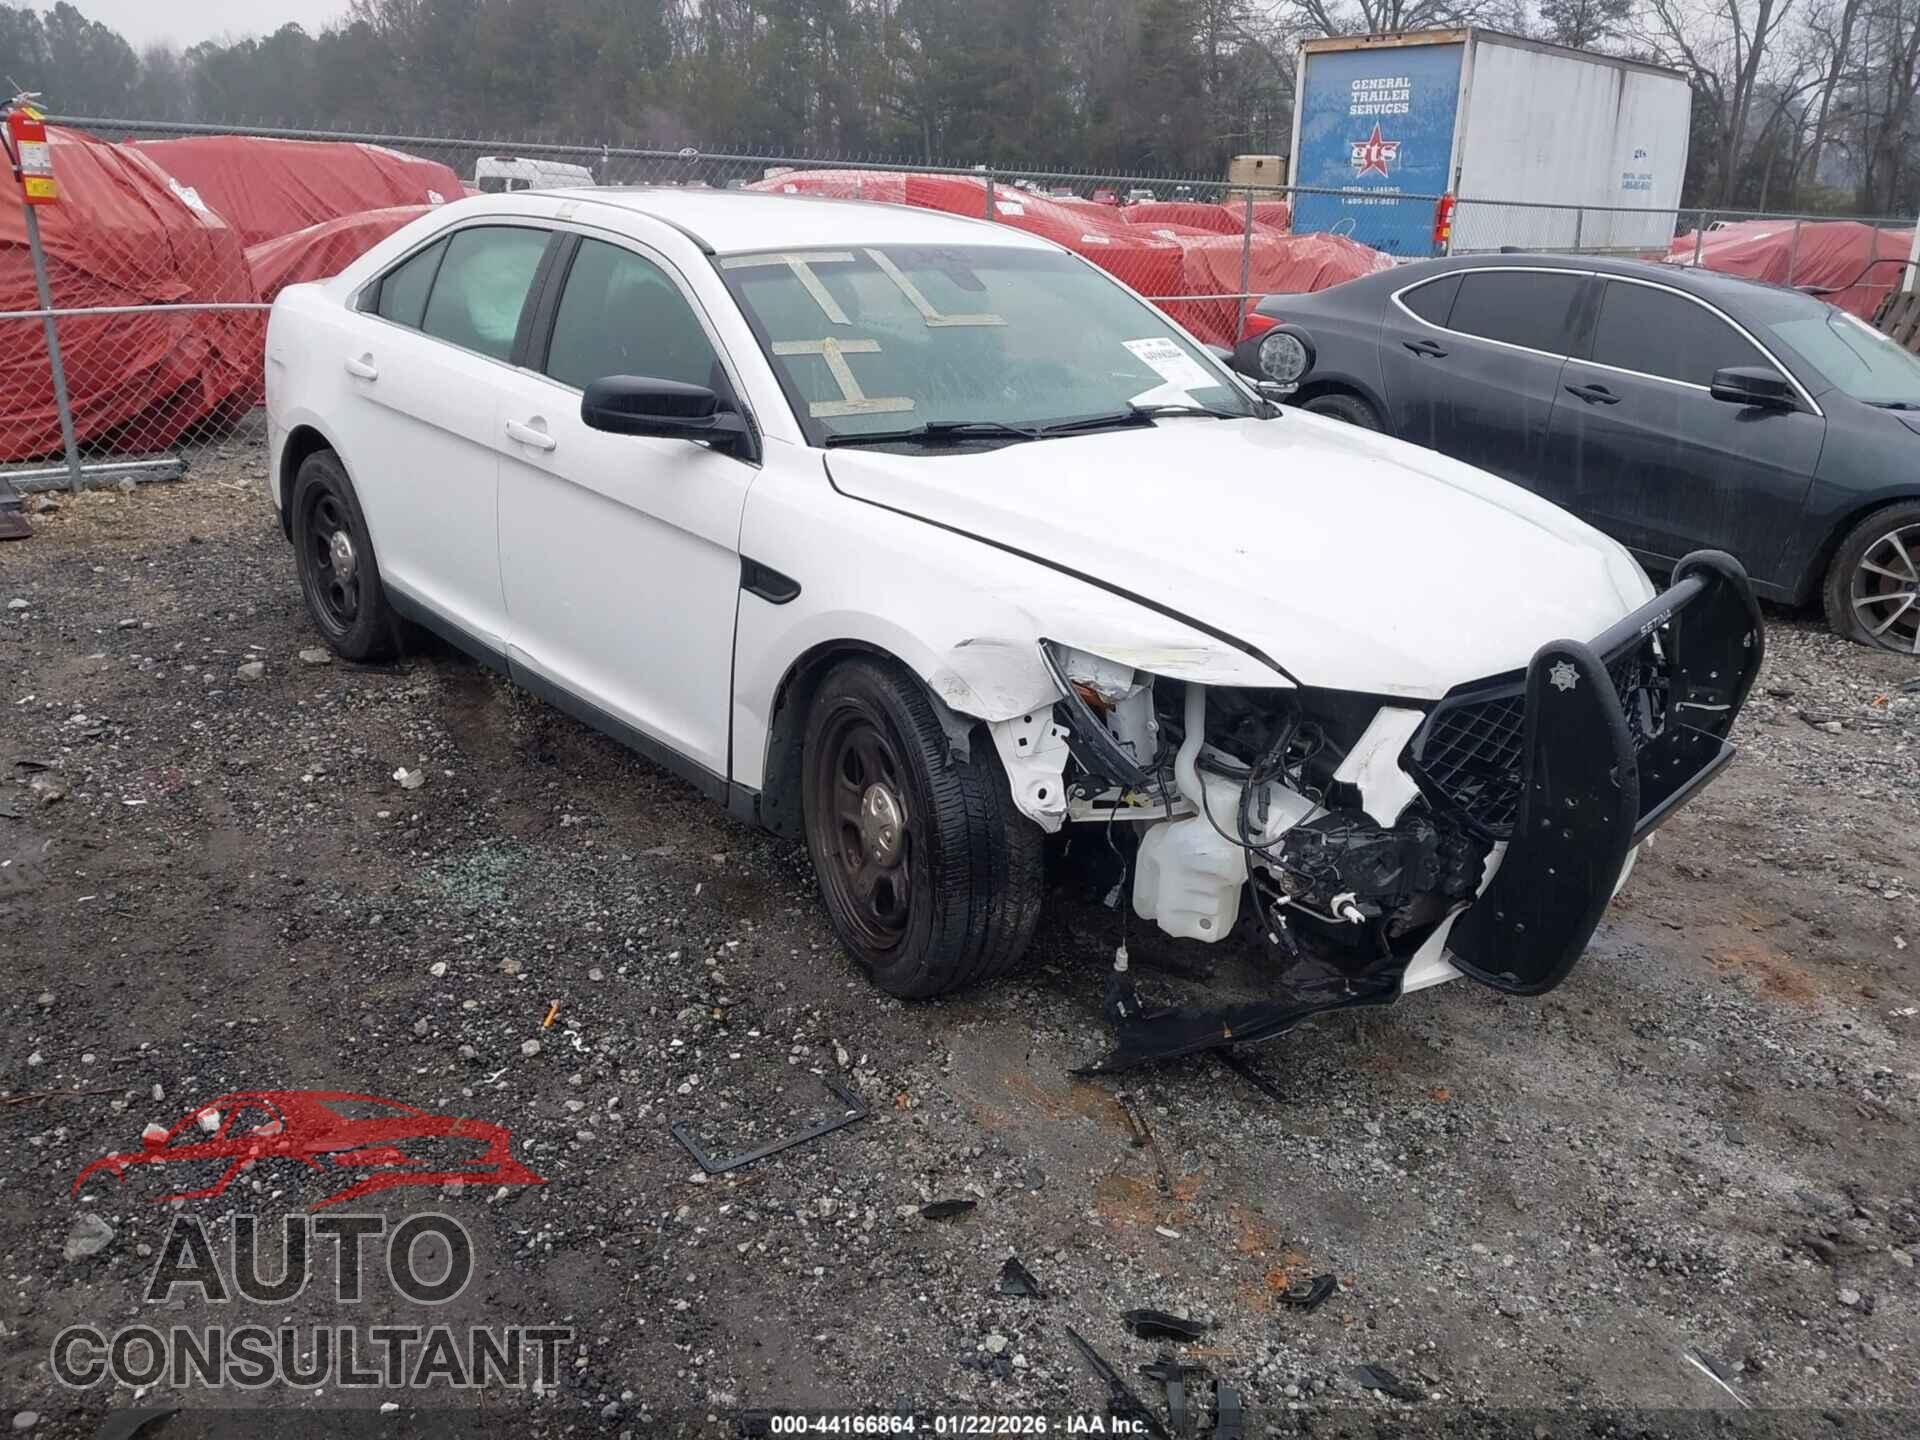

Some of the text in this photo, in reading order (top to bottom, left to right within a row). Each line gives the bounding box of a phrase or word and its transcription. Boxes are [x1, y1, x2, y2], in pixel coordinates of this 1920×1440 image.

[1352, 77, 1411, 90] GENERAL
[1351, 90, 1410, 104] TRAILER
[1349, 103, 1409, 115] SERVICES
[1352, 142, 1397, 168] gts
[1640, 608, 1672, 638] SETINA
